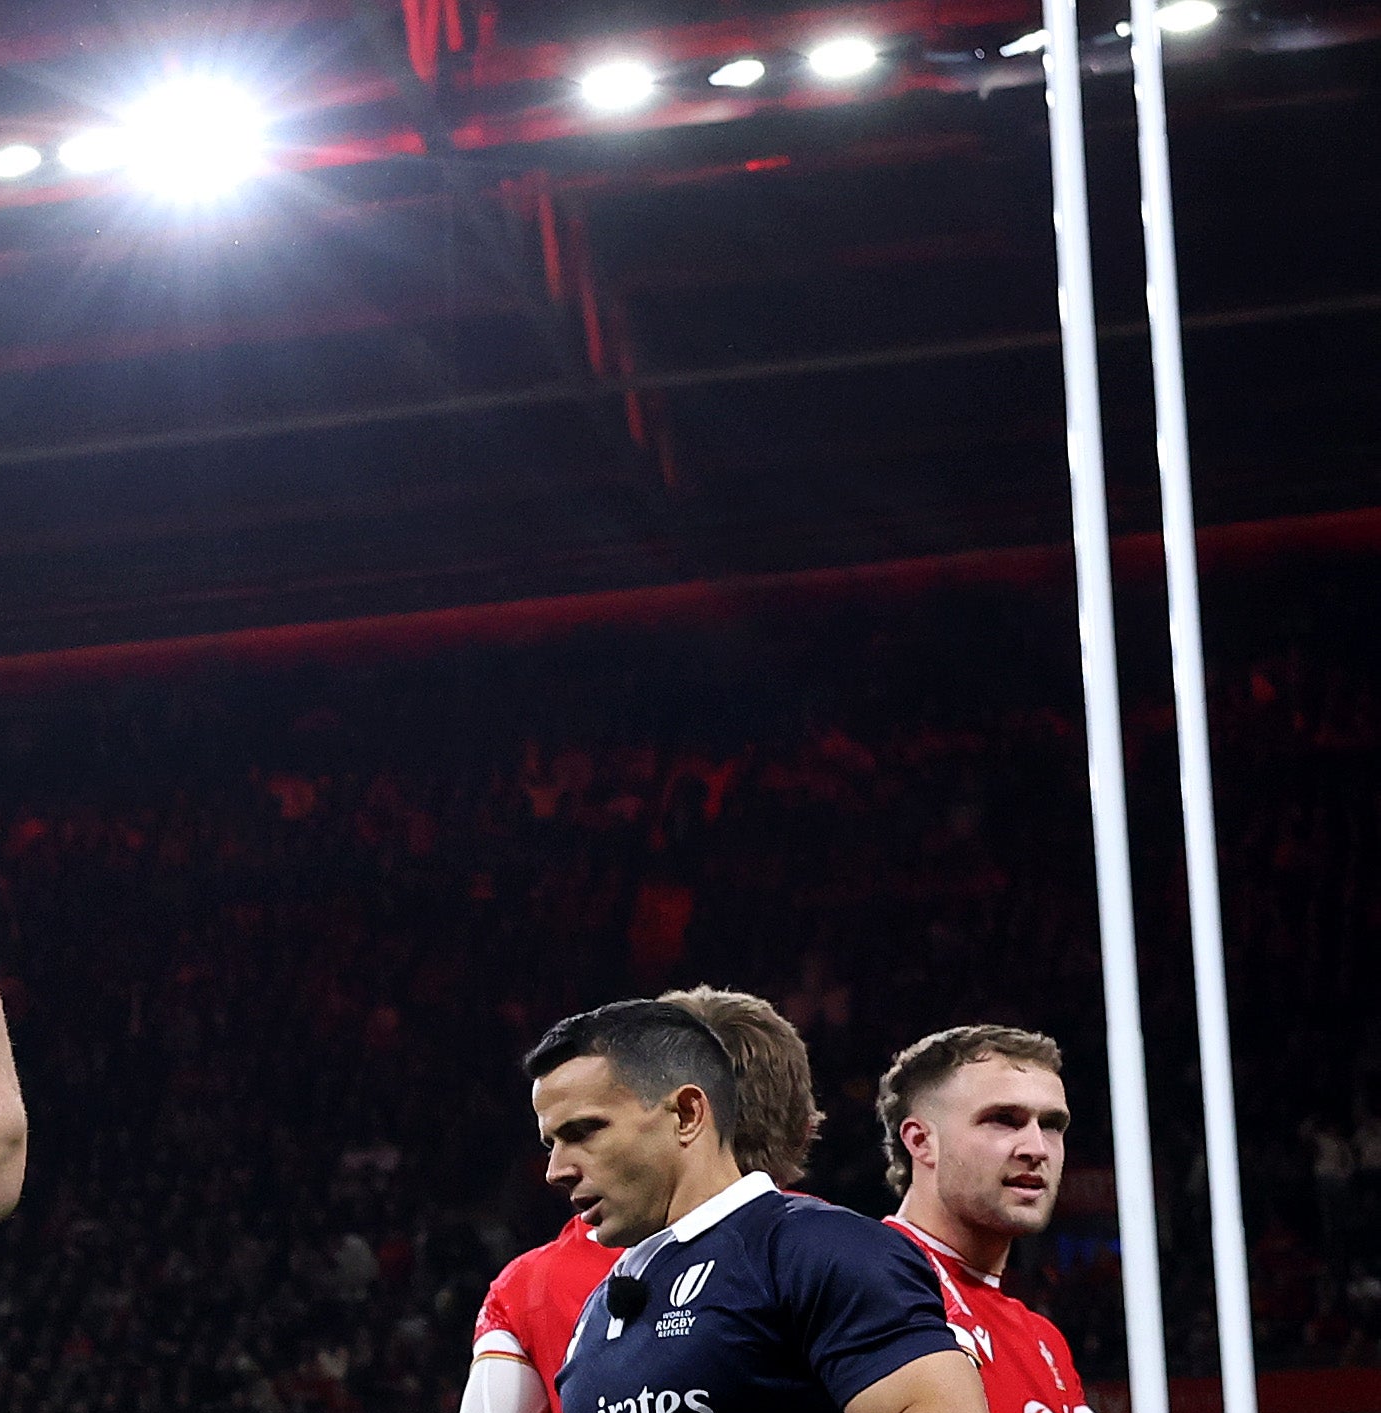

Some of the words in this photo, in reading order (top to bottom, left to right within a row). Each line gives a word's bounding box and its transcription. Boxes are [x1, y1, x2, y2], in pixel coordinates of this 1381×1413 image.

[662, 1309, 692, 1319] WORLD
[655, 1316, 696, 1331] RUGBY
[657, 1327, 690, 1338] REFEREE
